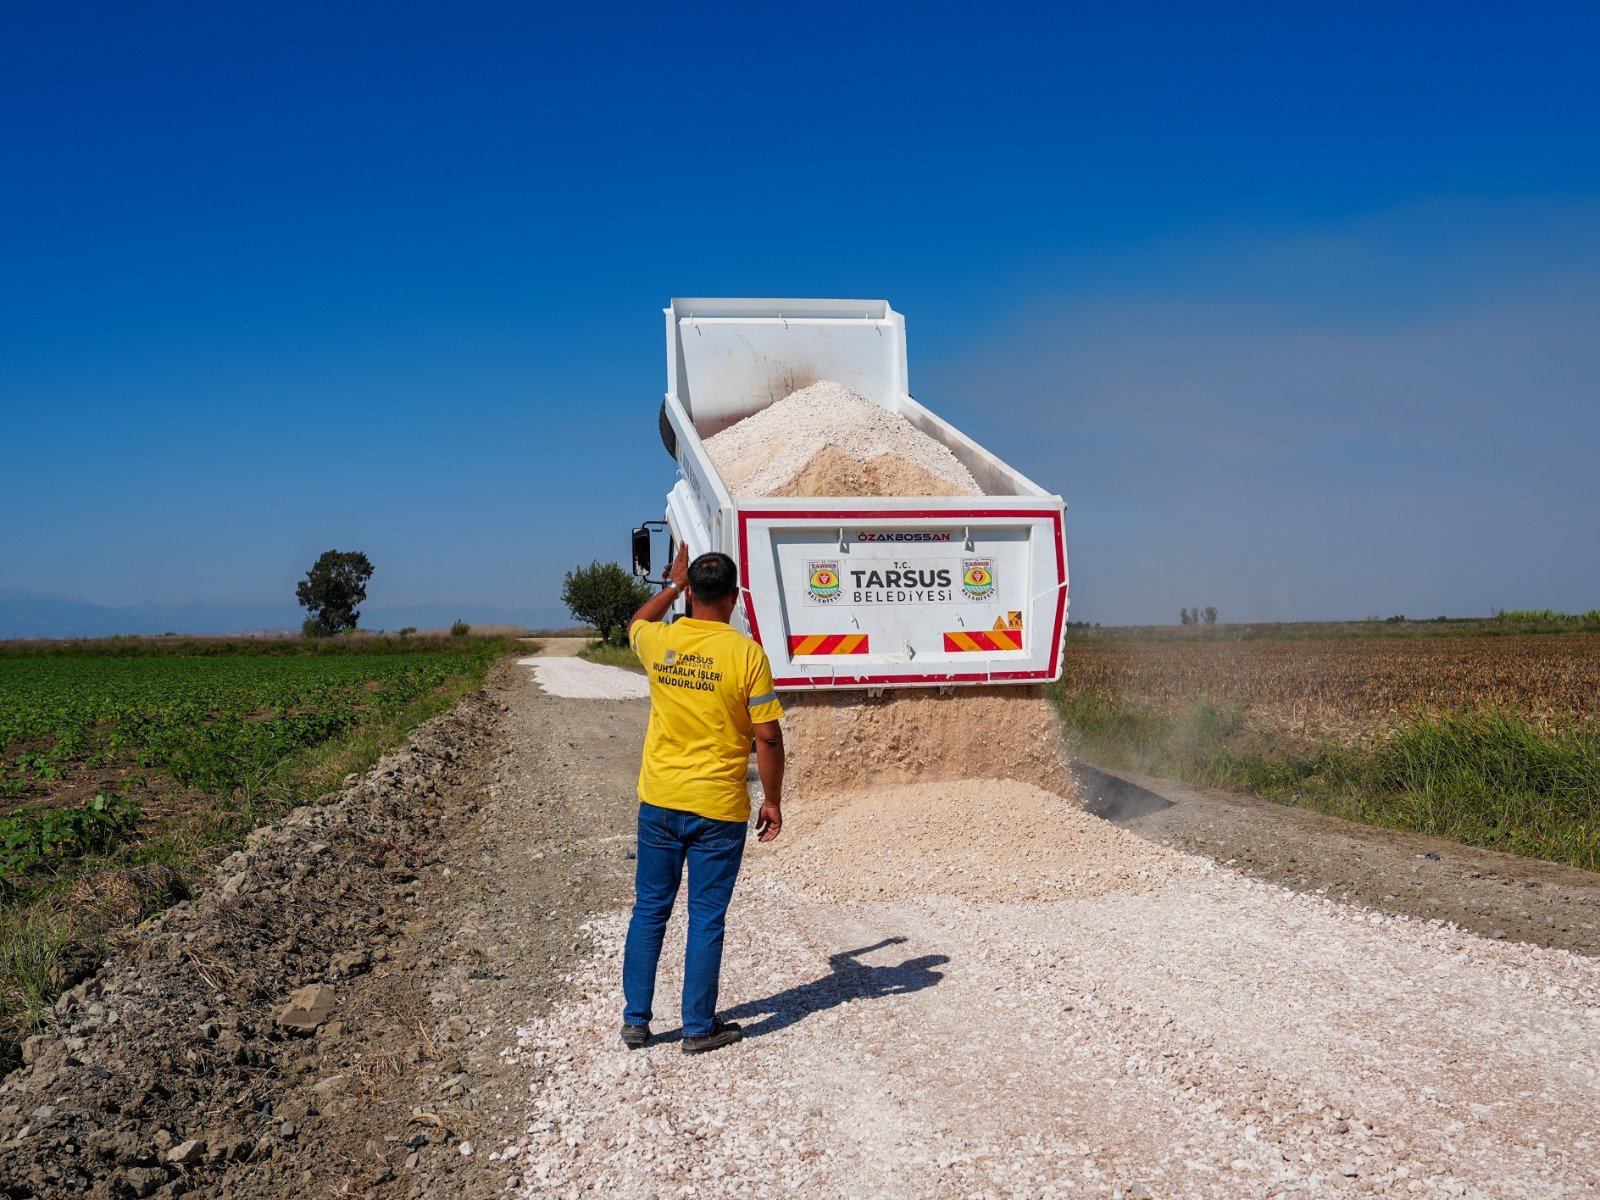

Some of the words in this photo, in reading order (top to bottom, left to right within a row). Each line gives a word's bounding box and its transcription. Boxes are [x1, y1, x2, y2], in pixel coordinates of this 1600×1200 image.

[858, 531, 950, 541] ÖZAKBOSSAN
[893, 561, 911, 569] T.C.
[851, 569, 952, 588] TARSUS
[678, 653, 714, 665] TARSUS
[653, 662, 696, 678] MUHTARLIK
[697, 669, 724, 682] İŞLERİ
[658, 675, 715, 692] MÜDÜRLÜĞÜ
